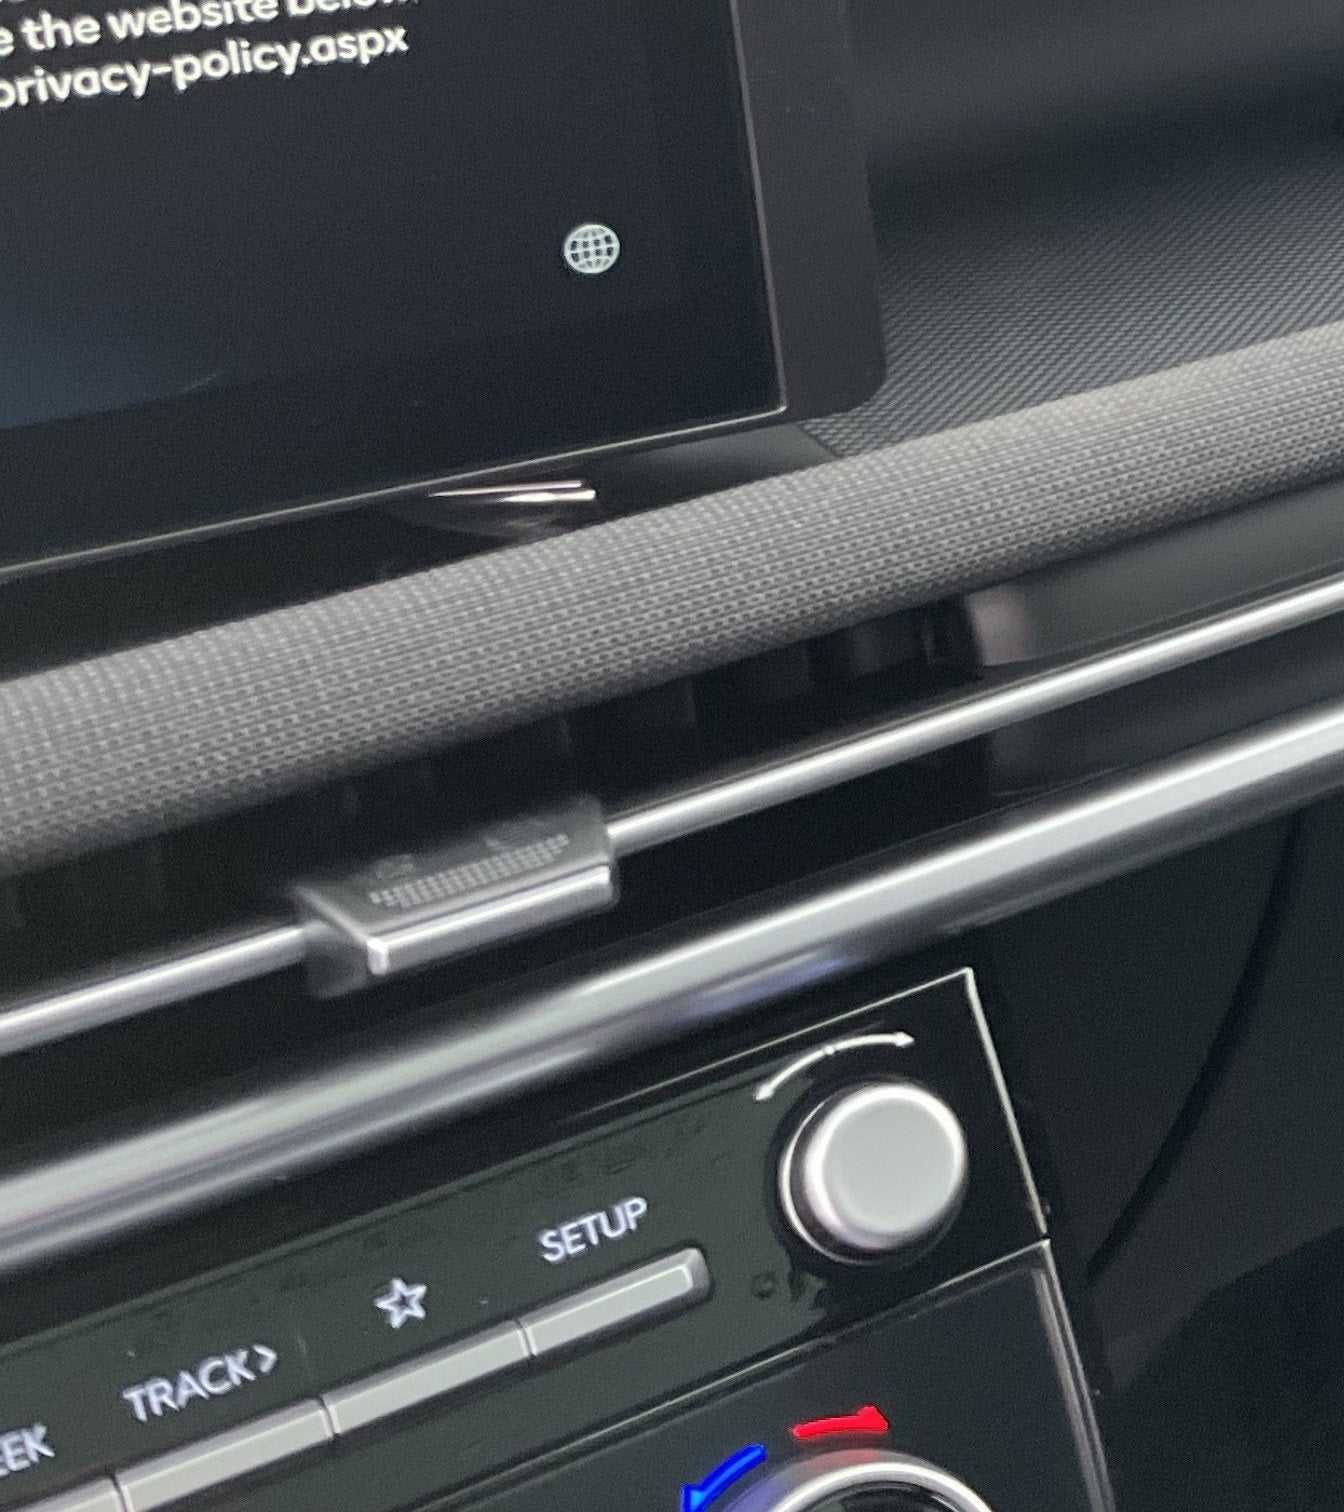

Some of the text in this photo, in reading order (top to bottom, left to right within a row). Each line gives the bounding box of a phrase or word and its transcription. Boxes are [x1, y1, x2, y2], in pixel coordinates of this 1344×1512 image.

[20, 10, 101, 51] the
[540, 1196, 648, 1263] SETUP
[122, 1346, 257, 1423] TRACK
